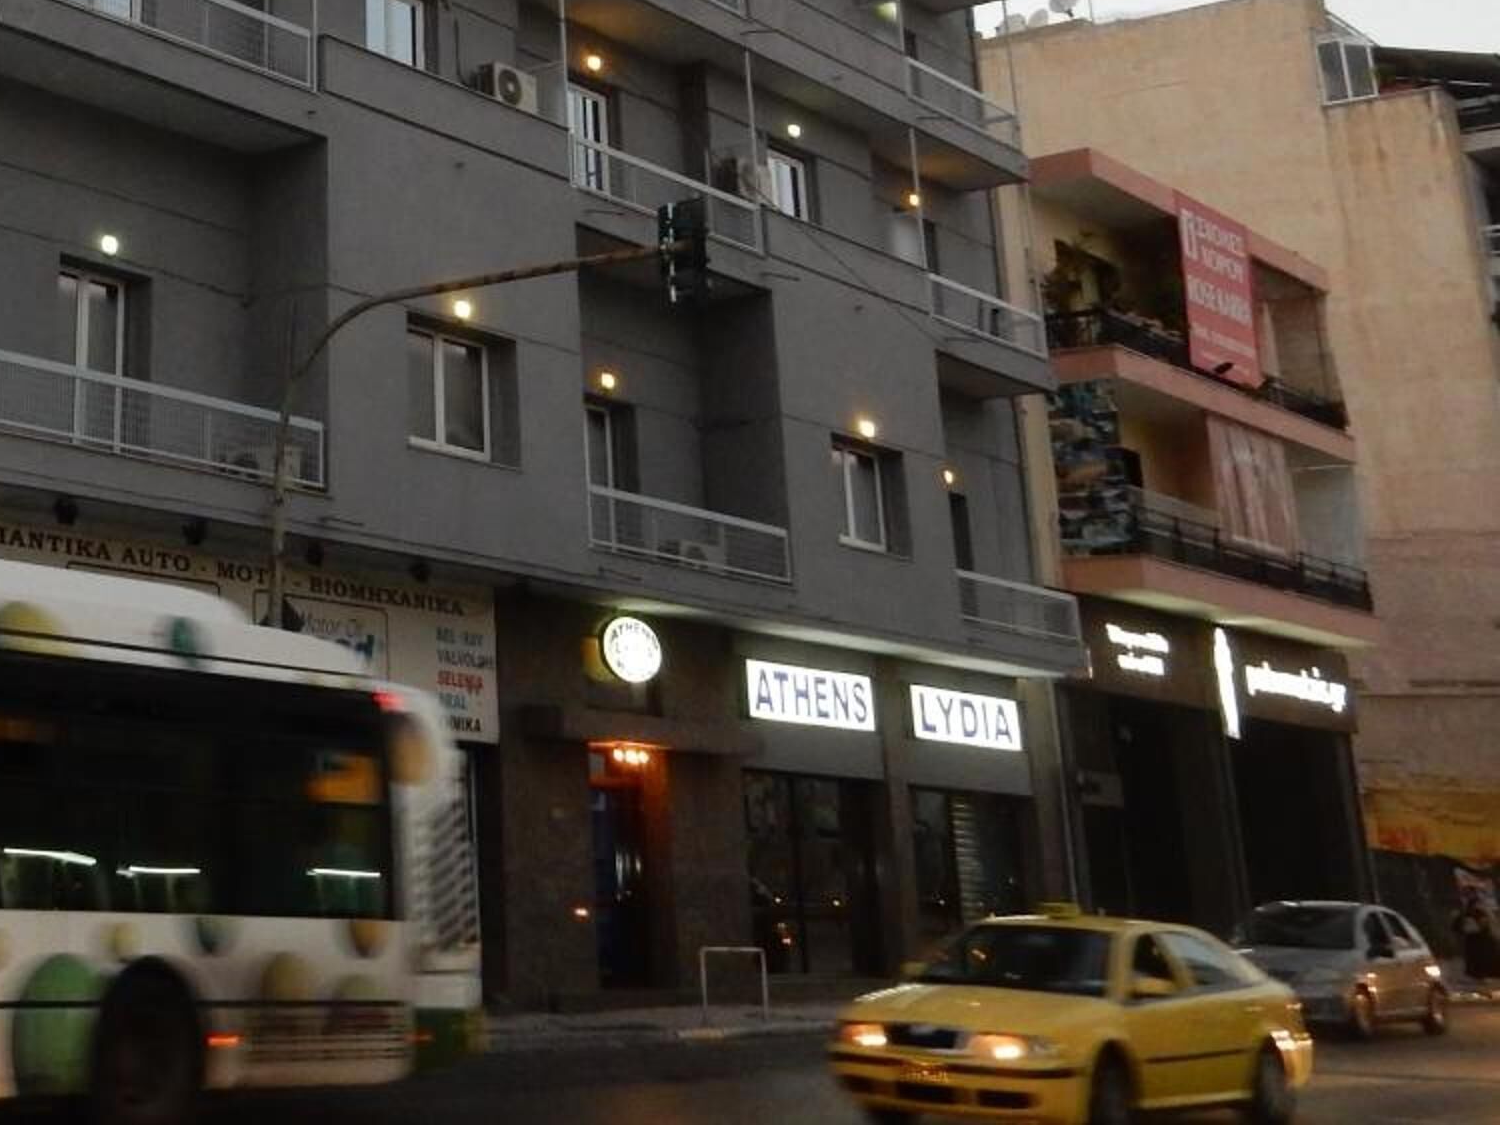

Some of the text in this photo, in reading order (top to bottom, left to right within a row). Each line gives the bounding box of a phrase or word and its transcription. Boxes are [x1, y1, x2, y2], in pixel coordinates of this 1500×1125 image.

[121, 546, 191, 572] AUTO
[215, 559, 283, 586] MOT
[755, 668, 1013, 744] ATHENS LYDIA
